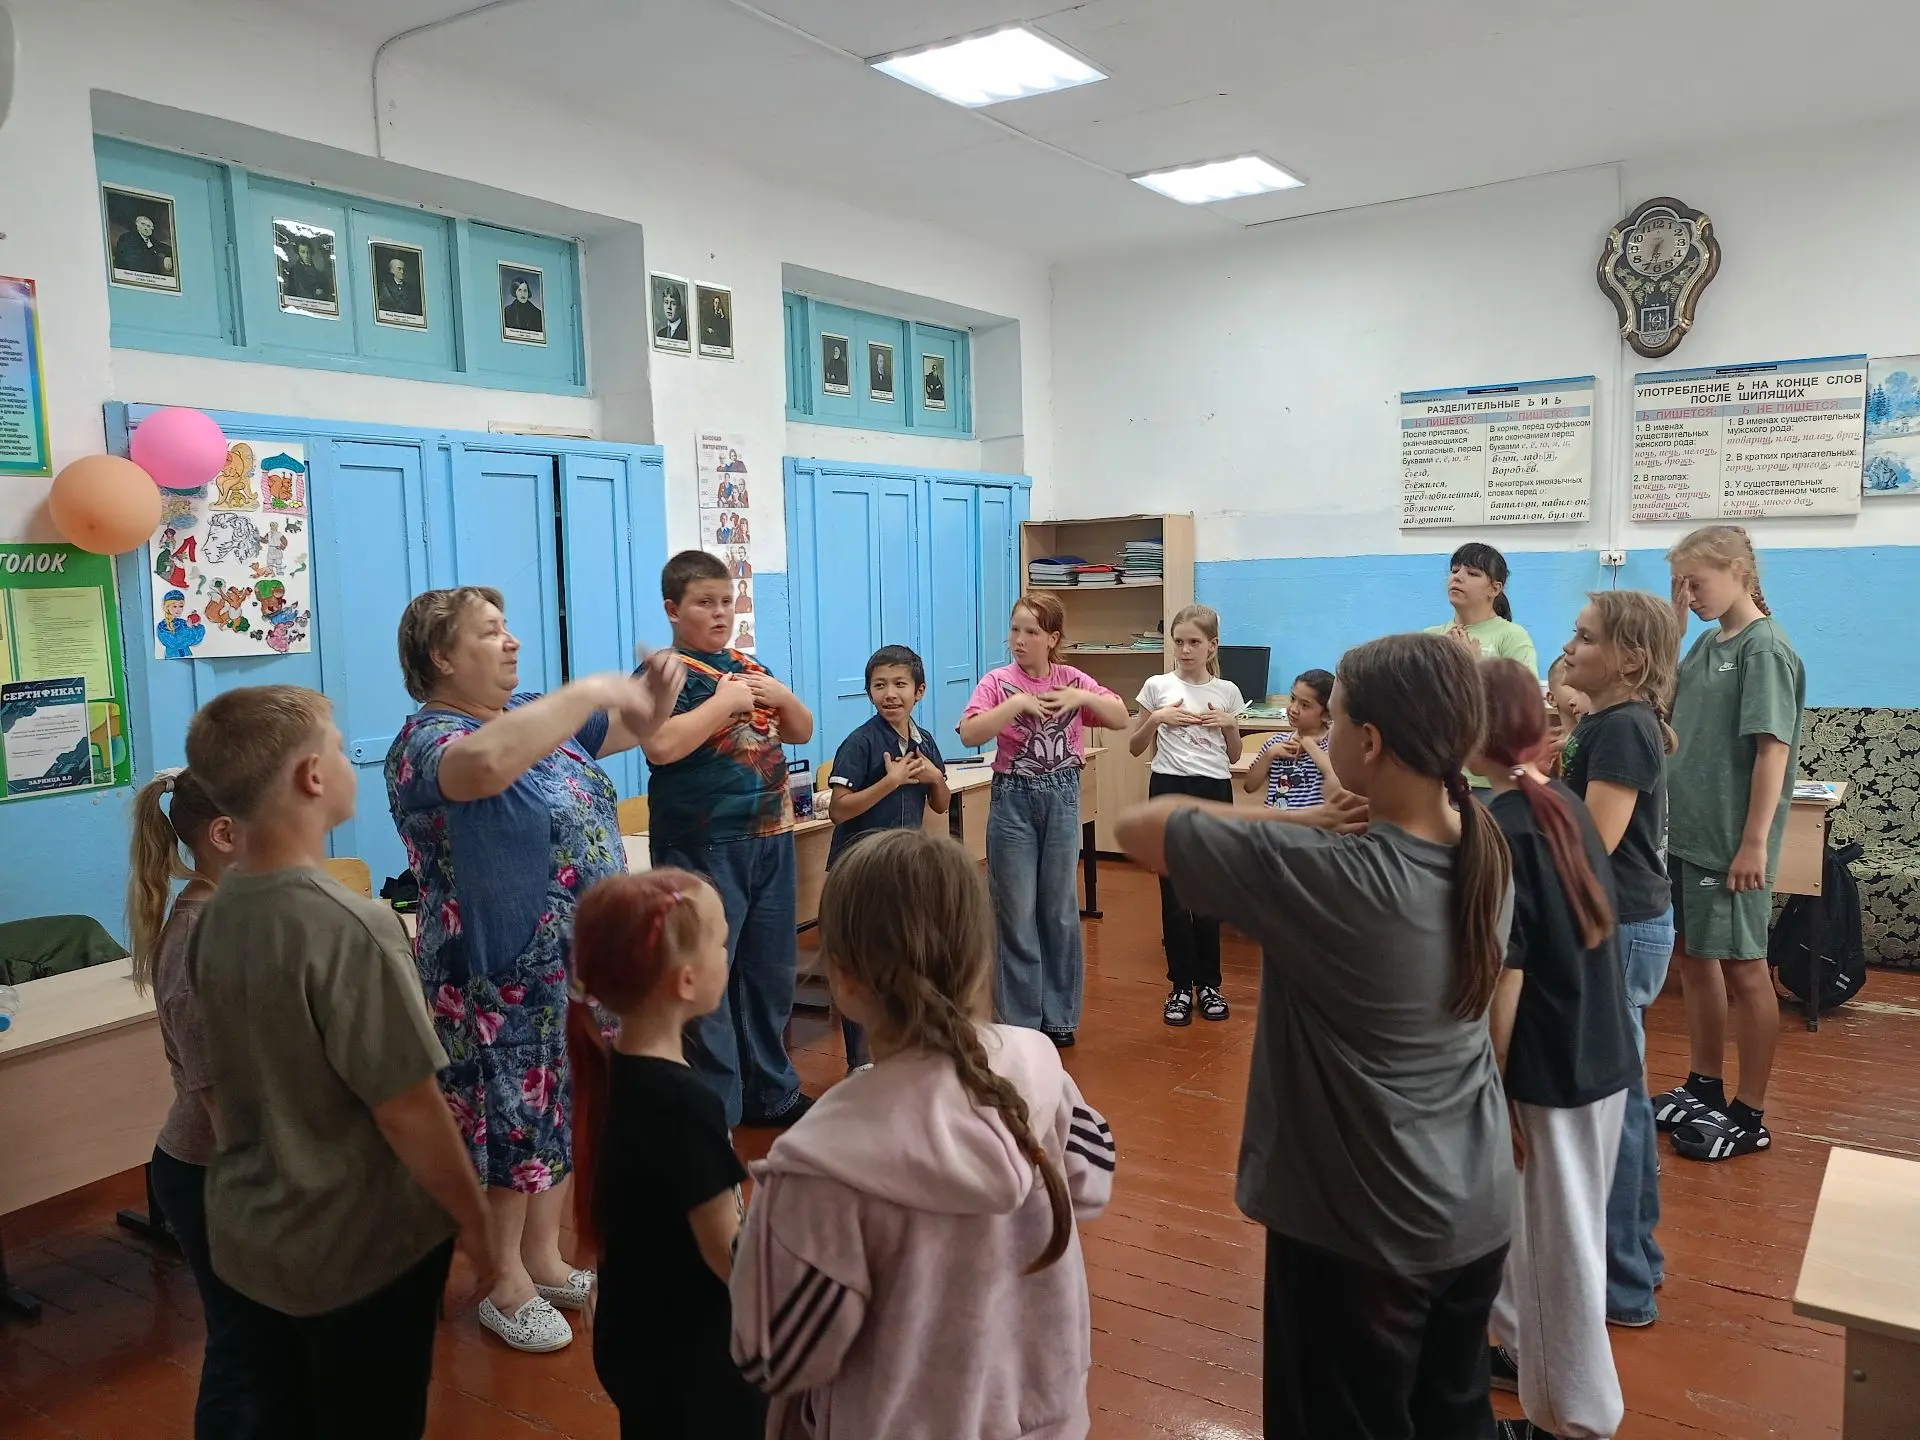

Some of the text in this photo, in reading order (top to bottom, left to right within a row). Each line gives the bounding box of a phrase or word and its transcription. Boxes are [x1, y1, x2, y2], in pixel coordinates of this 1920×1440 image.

[1642, 225, 1651, 233] 11
[1653, 220, 1664, 229] 12
[1634, 235, 1643, 243] 10
[1642, 262, 1651, 271] 7
[1665, 259, 1673, 267] 5
[1637, 374, 1862, 398] УПОТРЕБЛЕНИЕ Ь НА КОНЦЕ СЛОВ
[1690, 388, 1805, 404] ПОСЛЕ ШИПЯЩИХ
[1427, 400, 1520, 414] РАЗДЕЛИТЕЛЬНЫЕ
[1528, 398, 1535, 407] Ъ
[1541, 397, 1548, 406] И
[1555, 396, 1562, 405] Ь
[1757, 403, 1772, 414] НЕ
[1656, 408, 1717, 420] ПИШЕТСЯ:
[1737, 417, 1744, 425] В
[1746, 417, 1779, 425] именах
[1780, 412, 1861, 424] существительных
[1426, 415, 1477, 428] ПИШЕТСЯ:
[1489, 425, 1495, 433] В
[1522, 423, 1545, 431] перед
[1546, 420, 1591, 430] суффиксом
[1428, 428, 1470, 438] приставок,
[1645, 423, 1651, 432] В
[1653, 423, 1684, 431] именах
[1727, 424, 1794, 436] мужского рода:
[1505, 432, 1550, 441] окончанием
[1551, 430, 1575, 438] перед
[1635, 430, 1709, 441] существительных
[1402, 437, 1468, 447] оканчивающихся
[1489, 443, 1520, 452] буквами
[1634, 439, 1697, 448] женского рода:
[1413, 447, 1456, 456] согласные,
[1457, 445, 1482, 454] перед
[1736, 452, 1743, 461] В
[1745, 452, 1778, 461] кратких
[1780, 448, 1857, 460] прилагательных:
[1402, 457, 1434, 466] буквами
[1488, 477, 1583, 488] В некоторых иноязычных
[1643, 474, 1649, 482] В
[1651, 473, 1689, 481] глаголах:
[1735, 480, 1741, 488] У
[1743, 478, 1823, 490] существительных
[1515, 488, 1538, 497] перед
[1724, 485, 1839, 497] во множественном числе:
[3, 686, 83, 701] СЕРТИФИКАТ
[28, 776, 61, 786] ЗАРНИЦА
